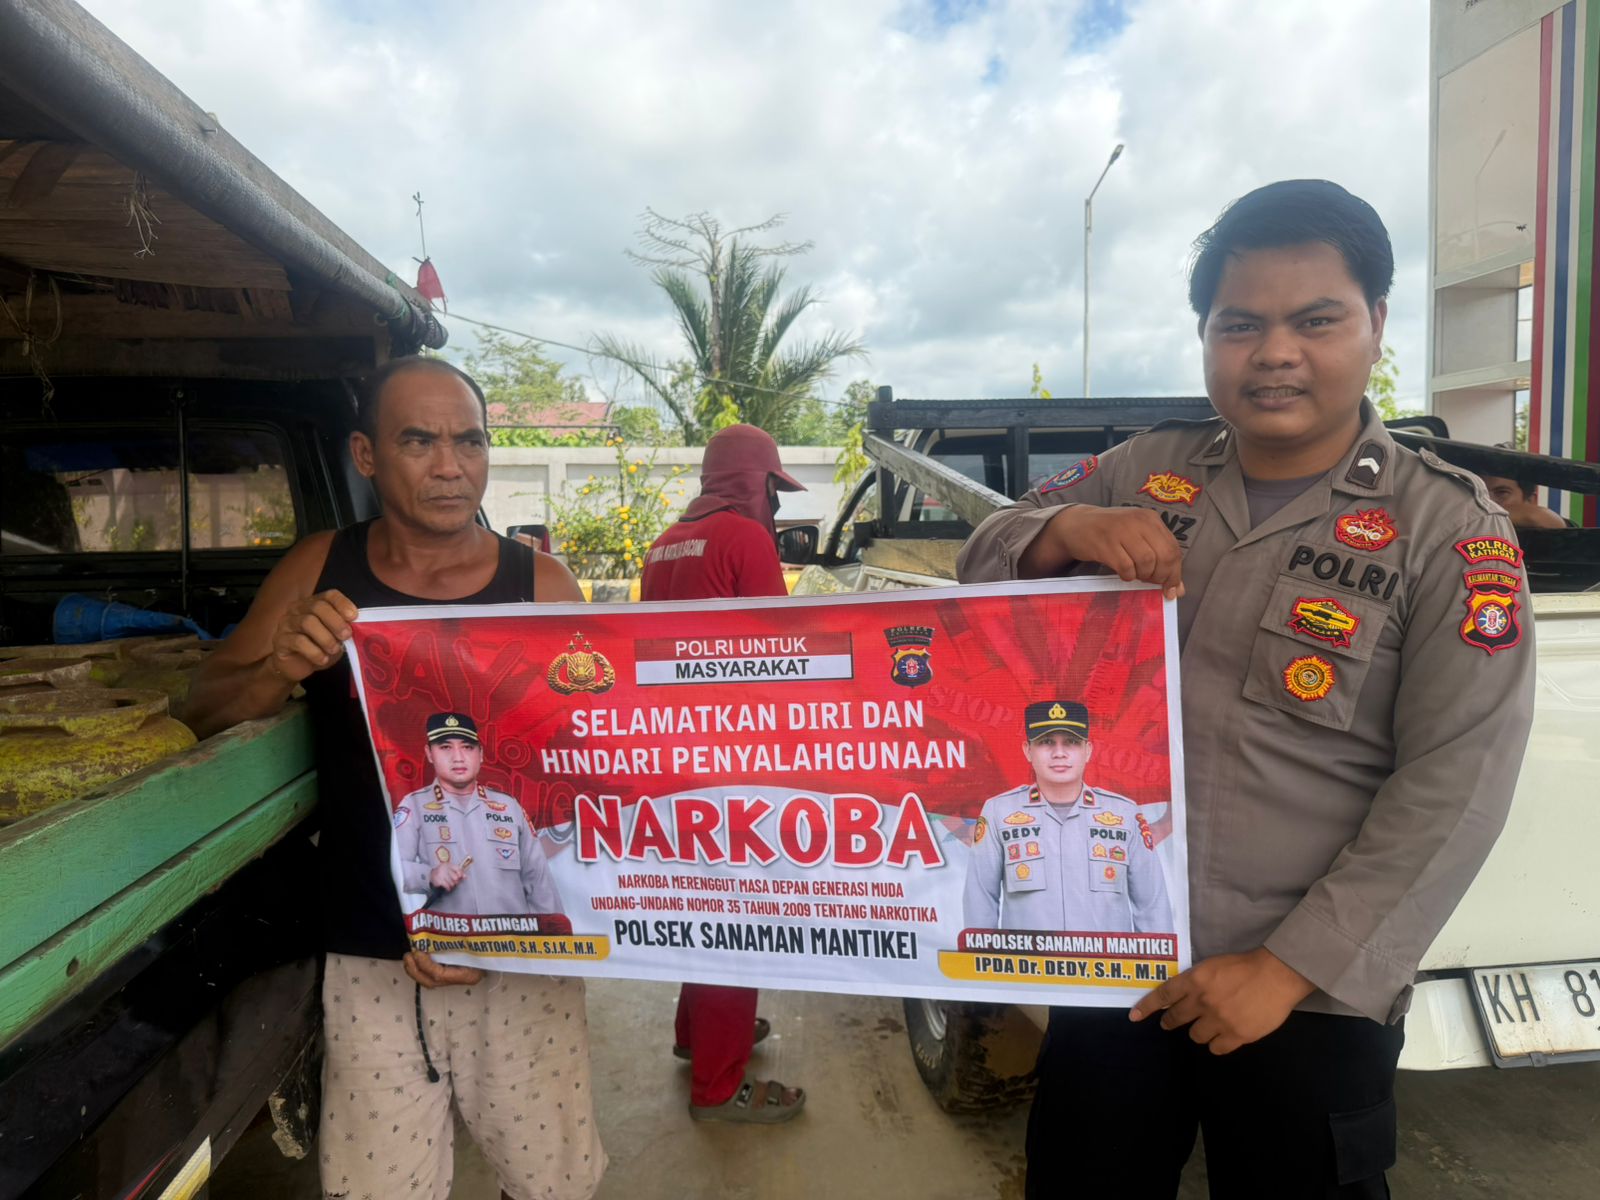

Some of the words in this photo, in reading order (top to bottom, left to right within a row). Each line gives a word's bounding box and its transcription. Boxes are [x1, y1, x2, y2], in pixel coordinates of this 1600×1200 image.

[1466, 540, 1515, 556] POLRES
[1288, 545, 1399, 600] POLRI
[675, 639, 734, 657] POLRI
[740, 636, 807, 655] UNTUK
[675, 658, 810, 679] MASYARAKAT
[571, 703, 777, 738] SELAMATKAN
[787, 702, 853, 730] DIRI
[862, 699, 924, 729] DAN
[540, 746, 663, 775] HINDARI
[672, 740, 966, 774] PENYALAHGUNAAN
[423, 814, 448, 823] DODIK
[485, 813, 514, 823] POLRI
[575, 792, 945, 868] NARKOBA
[1002, 827, 1041, 841] DEDY
[1089, 828, 1127, 842] POLRI
[618, 874, 669, 889] NARKOBA
[671, 875, 735, 892] MERENGGUT
[739, 879, 769, 893] MASA
[773, 880, 809, 895] DEPAN
[812, 881, 868, 897] GENERASI
[871, 882, 904, 898] MUDA
[591, 896, 684, 911] UNDANG-UNDANG
[687, 898, 724, 913] NOMOR
[727, 899, 741, 914] 35
[743, 901, 780, 916] TAHUN
[783, 902, 811, 917] 2009
[814, 903, 867, 919] TENTANG
[870, 905, 938, 922] NARKOTIKA
[412, 913, 469, 932] KAPOLRES
[471, 917, 539, 932] KATINGAN
[573, 941, 598, 955] M.H.
[614, 919, 695, 948] POLSEK
[700, 922, 804, 954] SANAMAN
[810, 926, 918, 960] MANTIKEI
[965, 933, 1033, 951] KAPOLSEK
[1036, 935, 1104, 953] SANAMAN
[1106, 937, 1173, 956] MANTIKEI
[975, 957, 1016, 974] IPDA
[1018, 959, 1041, 975] Dr.
[1044, 960, 1091, 979] DEDY,
[1094, 962, 1131, 980] S.H.,
[1482, 973, 1541, 1023] KH
